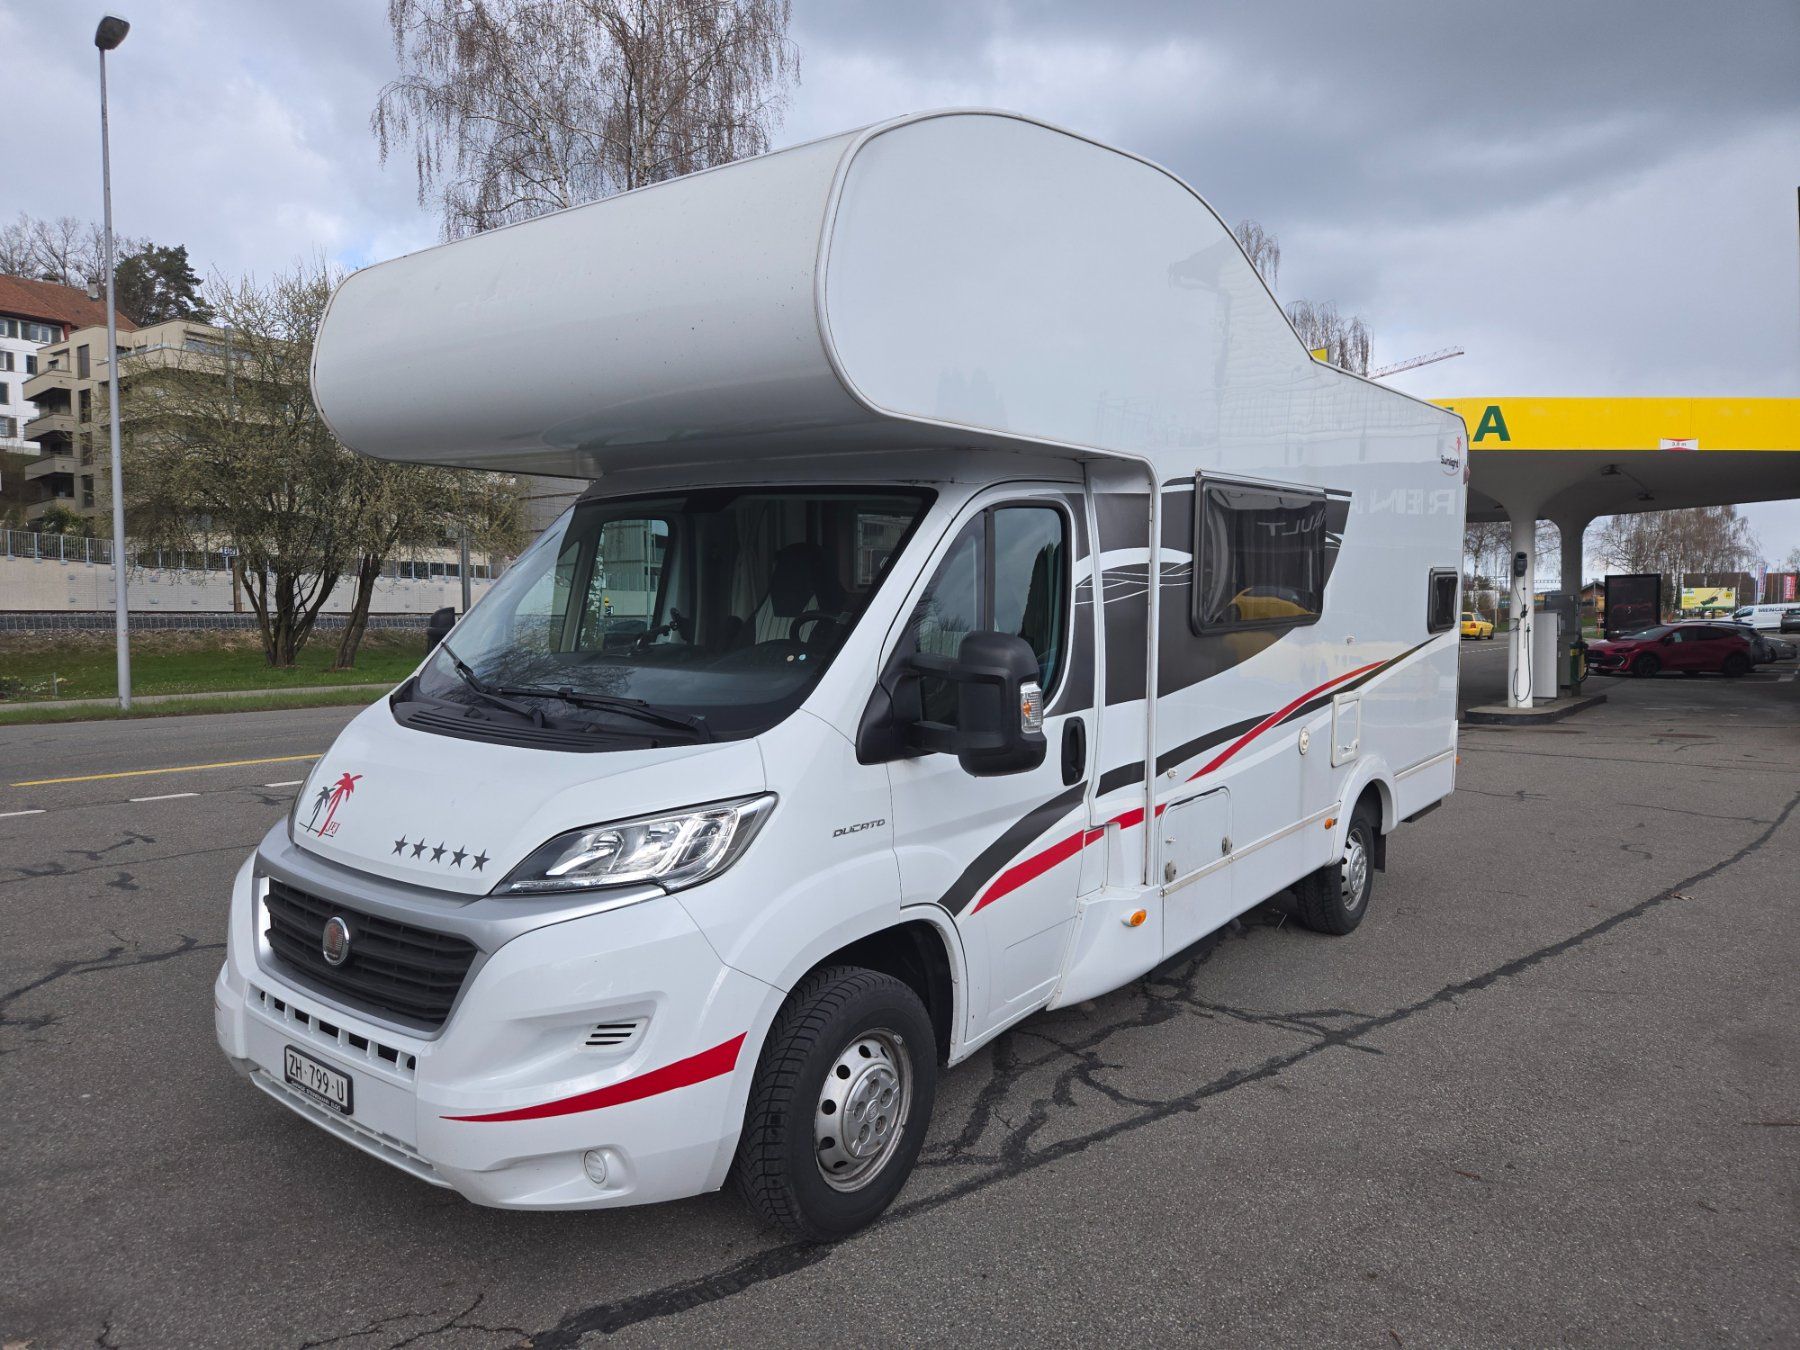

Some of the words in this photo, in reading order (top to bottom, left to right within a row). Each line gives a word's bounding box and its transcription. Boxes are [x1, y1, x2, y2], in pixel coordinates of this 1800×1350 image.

[1466, 405, 1511, 442] A
[1440, 454, 1459, 470] Sunlight
[832, 818, 886, 838] DUCATO
